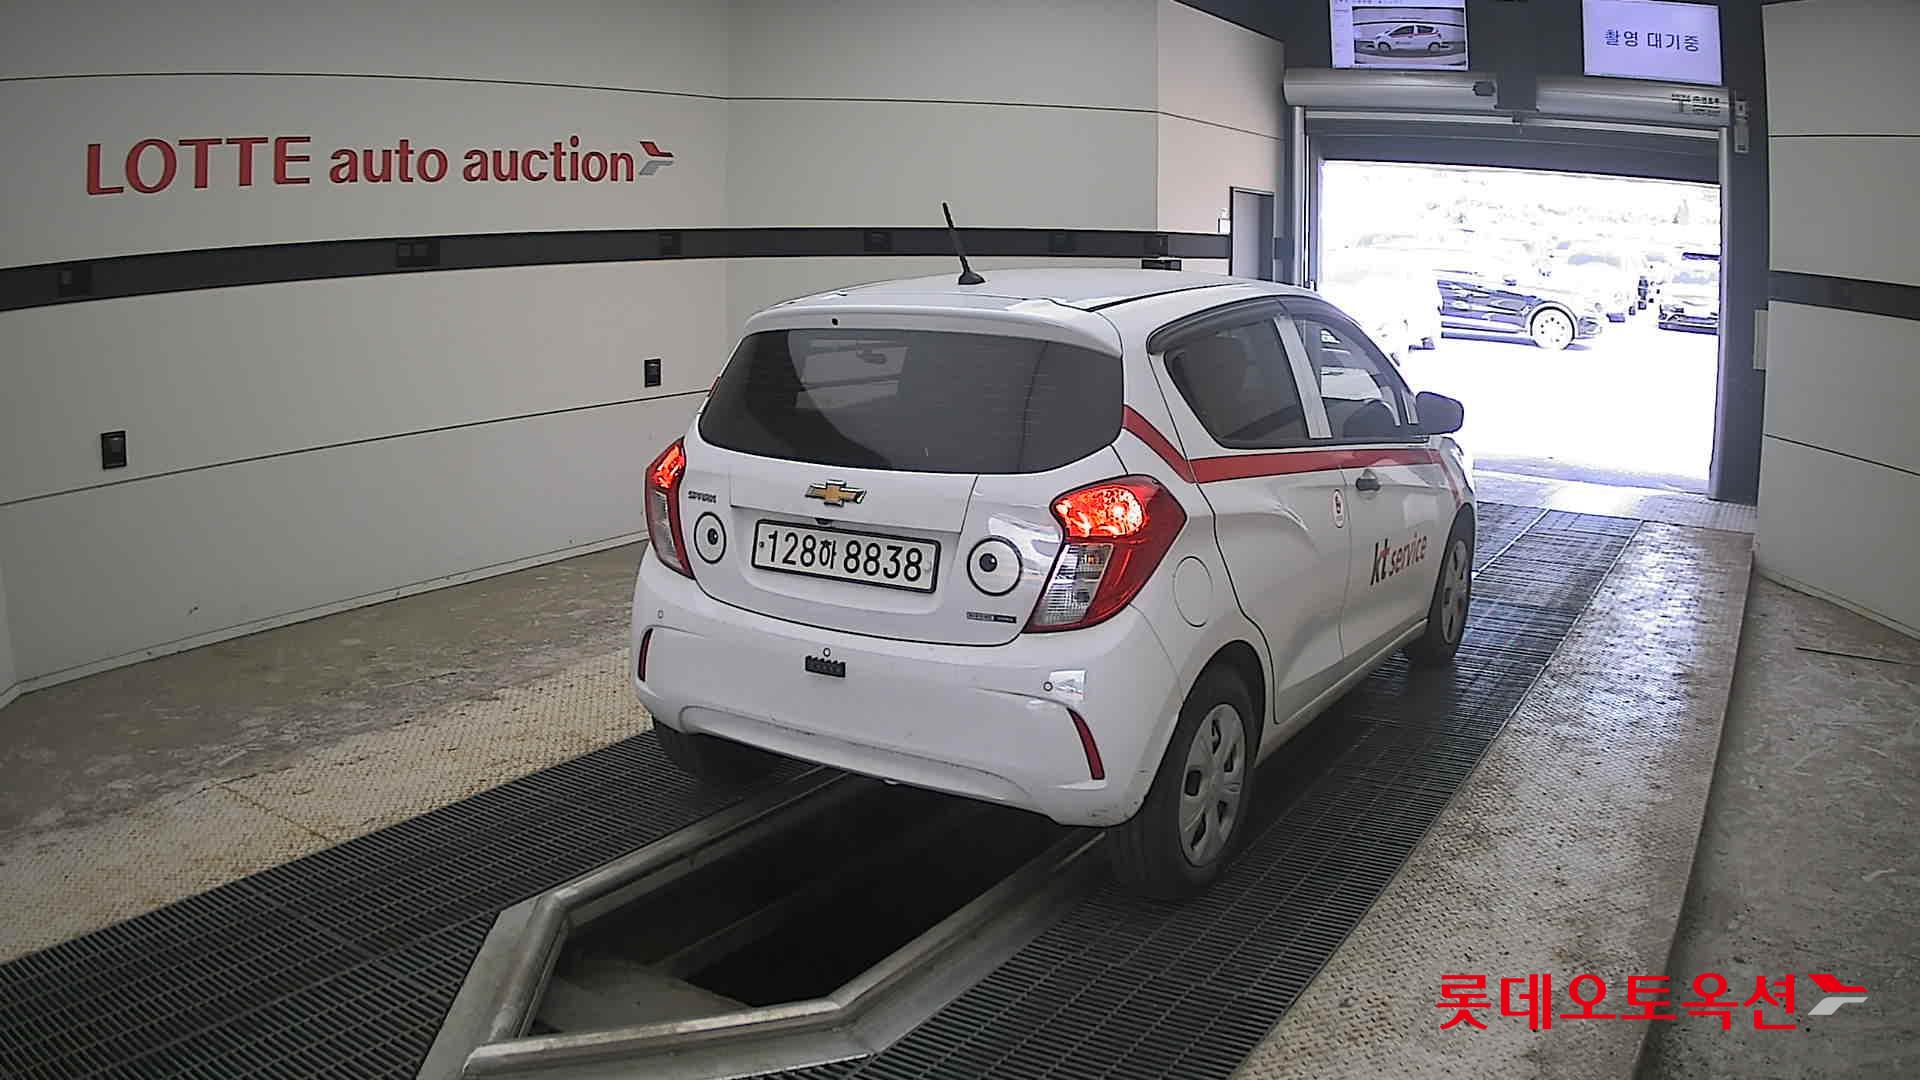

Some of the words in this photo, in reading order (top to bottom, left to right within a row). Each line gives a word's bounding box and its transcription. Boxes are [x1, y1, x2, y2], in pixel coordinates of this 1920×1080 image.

[1647, 32, 1699, 52] 대기중
[86, 136, 311, 196] LOTTE
[329, 139, 448, 183] auto
[463, 136, 634, 182] auction
[768, 530, 837, 570] 128하
[843, 540, 922, 581] 8838
[1389, 532, 1427, 577] service
